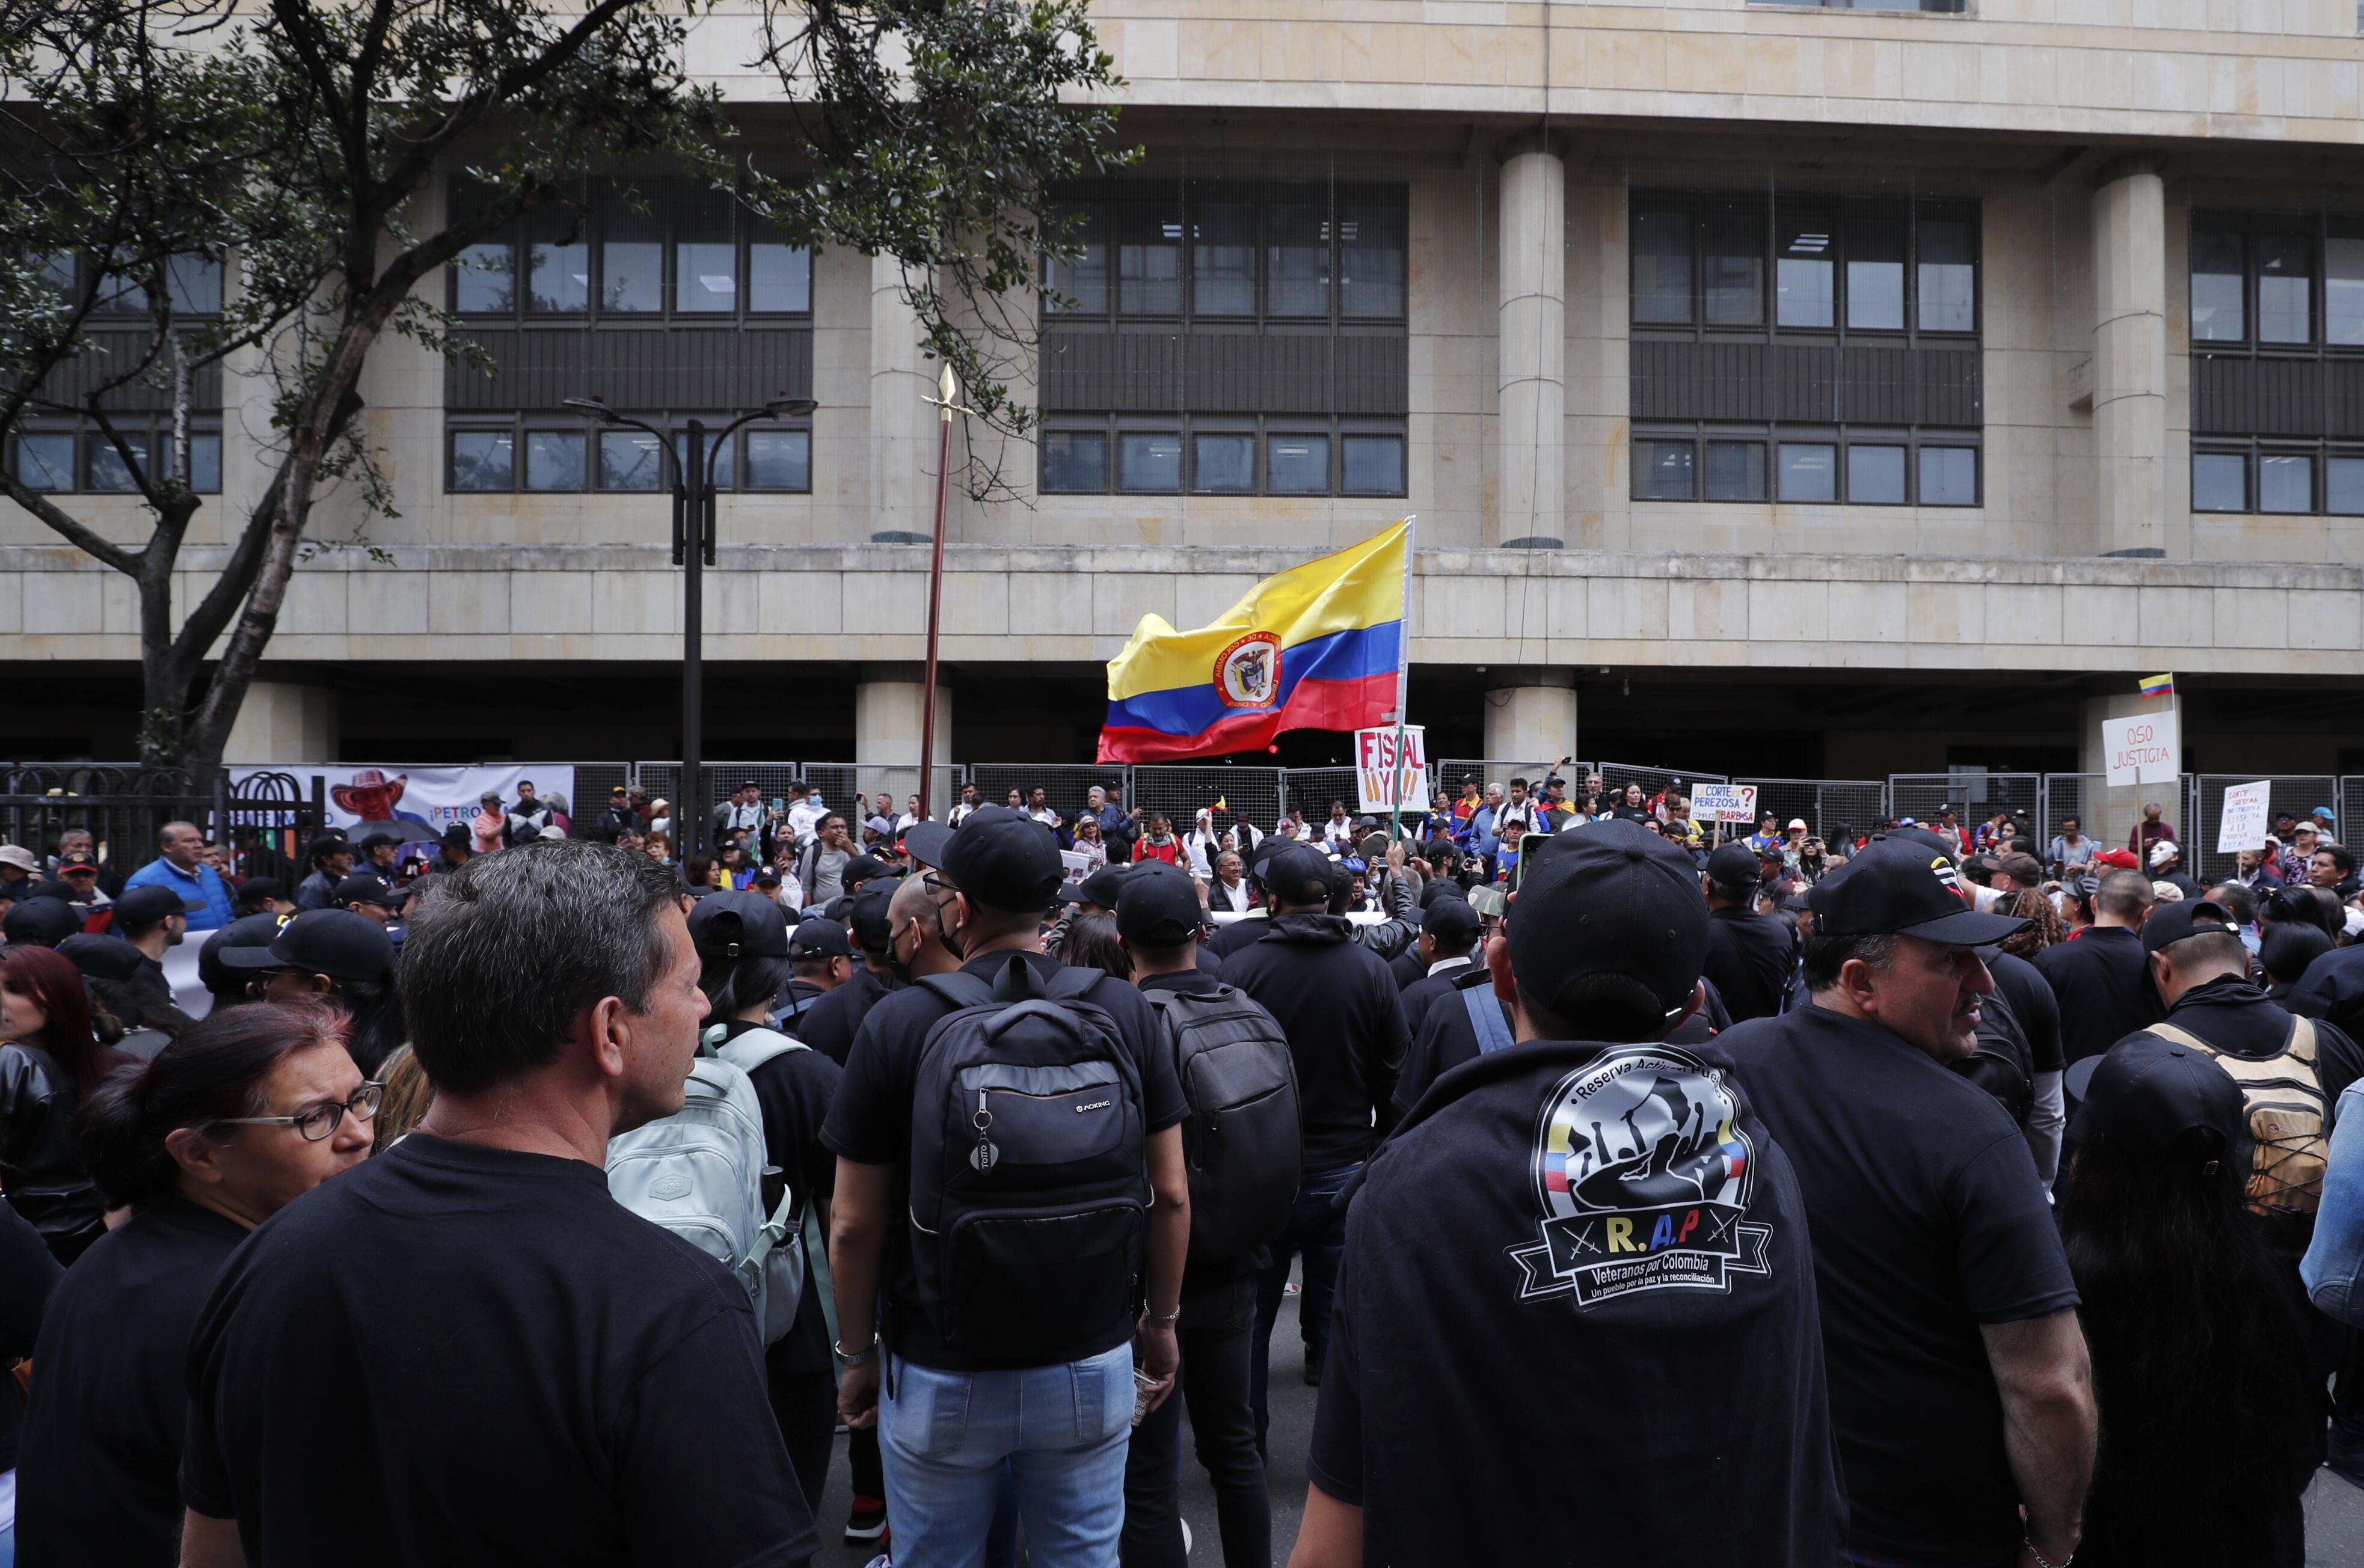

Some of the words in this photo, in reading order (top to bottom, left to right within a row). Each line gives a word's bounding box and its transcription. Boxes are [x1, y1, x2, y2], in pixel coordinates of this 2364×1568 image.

[2113, 746, 2170, 770] JUSTICIA
[1693, 797, 1740, 808] PEREZOSA
[1694, 788, 1705, 797] LA
[1705, 785, 1732, 797] CORTE
[1575, 1063, 1632, 1100] Reserva
[1084, 1100, 1111, 1111] AOKING
[980, 1145, 989, 1169] TOTTO
[1591, 1264, 1645, 1285] Veteranos
[1645, 1258, 1662, 1276] por
[1662, 1252, 1709, 1271] Colombia
[1591, 1288, 1602, 1298] Un
[1603, 1282, 1626, 1297] pueblo
[1626, 1279, 1637, 1290] por
[1638, 1277, 1644, 1285] la
[1644, 1275, 1656, 1286] paz
[1656, 1275, 1662, 1284] y
[1662, 1273, 1669, 1282] la
[1669, 1272, 1715, 1284] reconciliación
